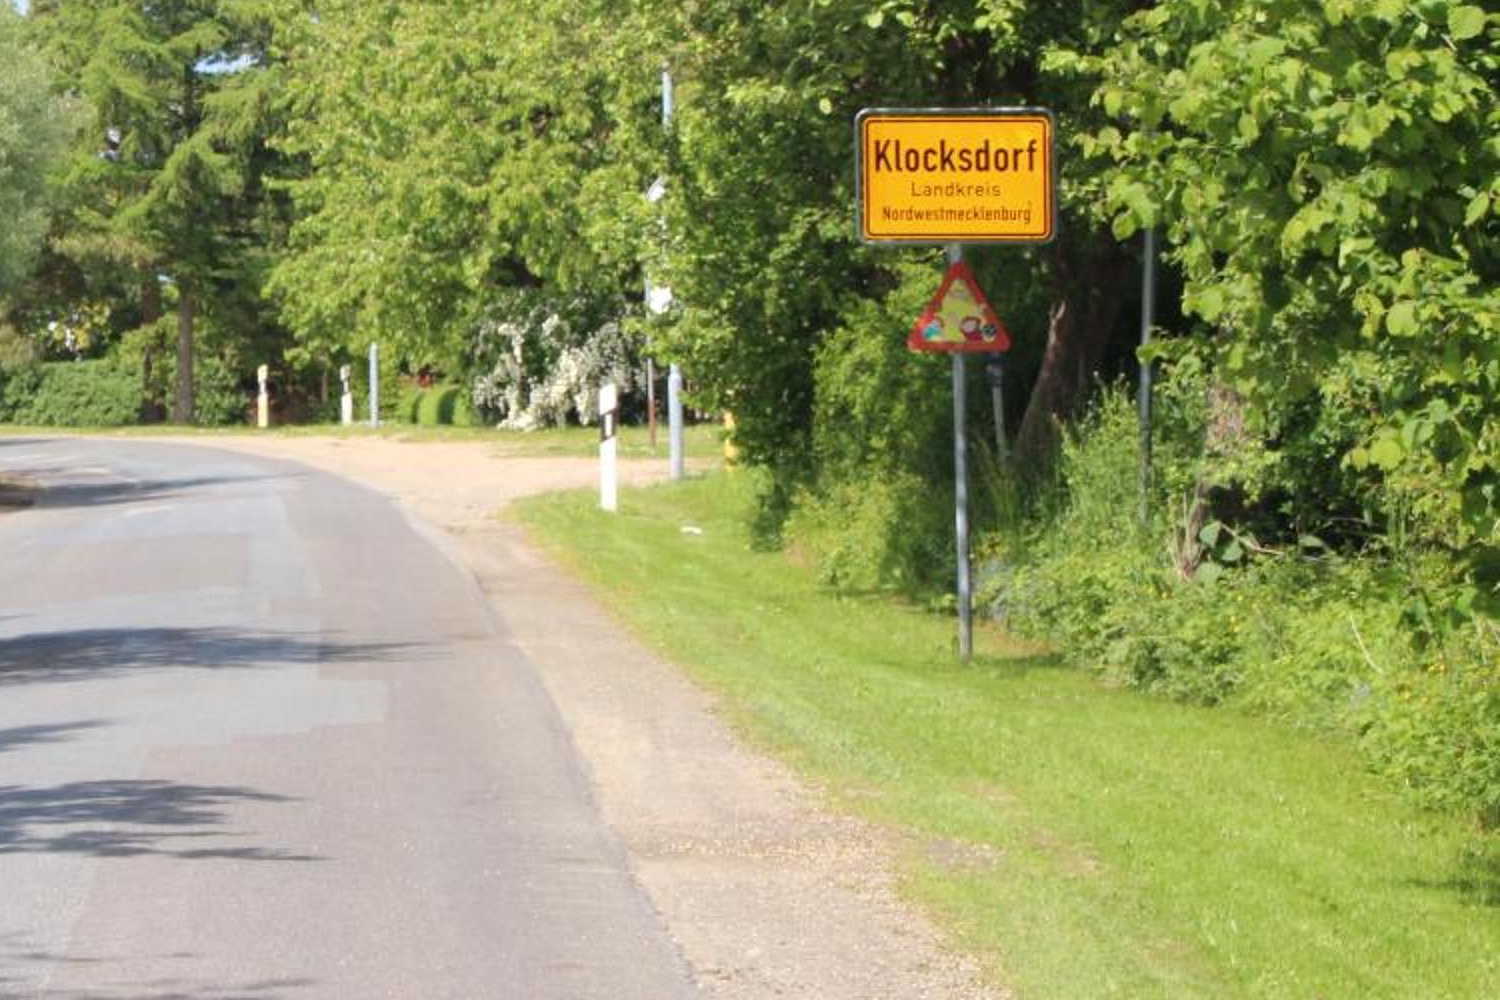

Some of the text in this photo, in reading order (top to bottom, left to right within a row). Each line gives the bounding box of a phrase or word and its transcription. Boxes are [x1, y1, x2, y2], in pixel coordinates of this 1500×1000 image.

[874, 139, 1037, 172] Klocksdorf
[911, 182, 1001, 197] Landkreis
[883, 206, 1031, 224] Nordwestmecklenburg
